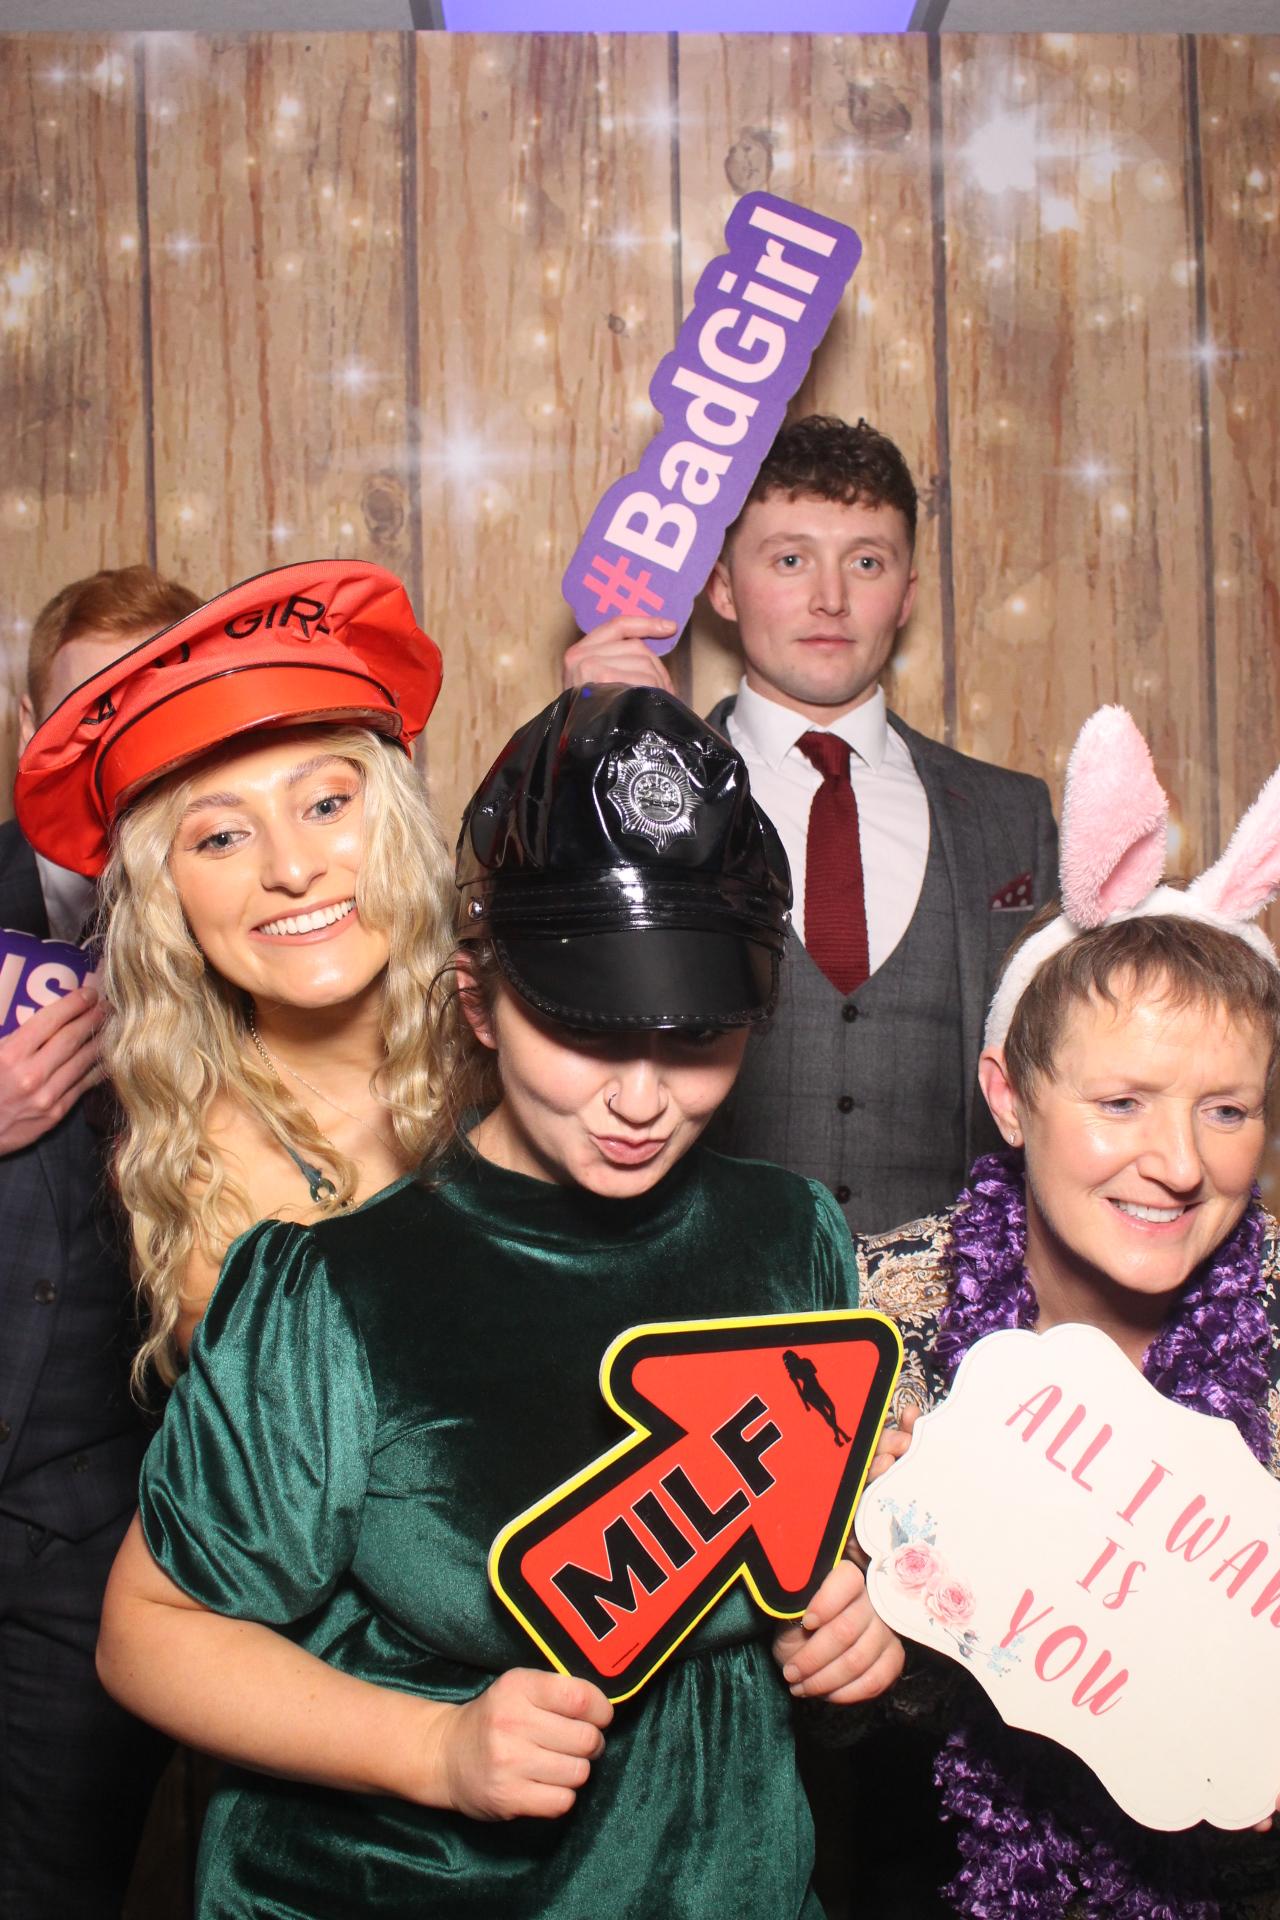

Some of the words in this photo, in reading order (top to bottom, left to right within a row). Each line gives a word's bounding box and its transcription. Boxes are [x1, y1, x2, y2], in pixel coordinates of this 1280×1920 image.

[583, 206, 838, 616] #BadGirl
[550, 1394, 783, 1642] MILF
[1004, 1384, 1113, 1492] ALL
[1116, 1459, 1173, 1527] I
[1075, 1536, 1147, 1610] IS
[999, 1588, 1129, 1716] YOU
